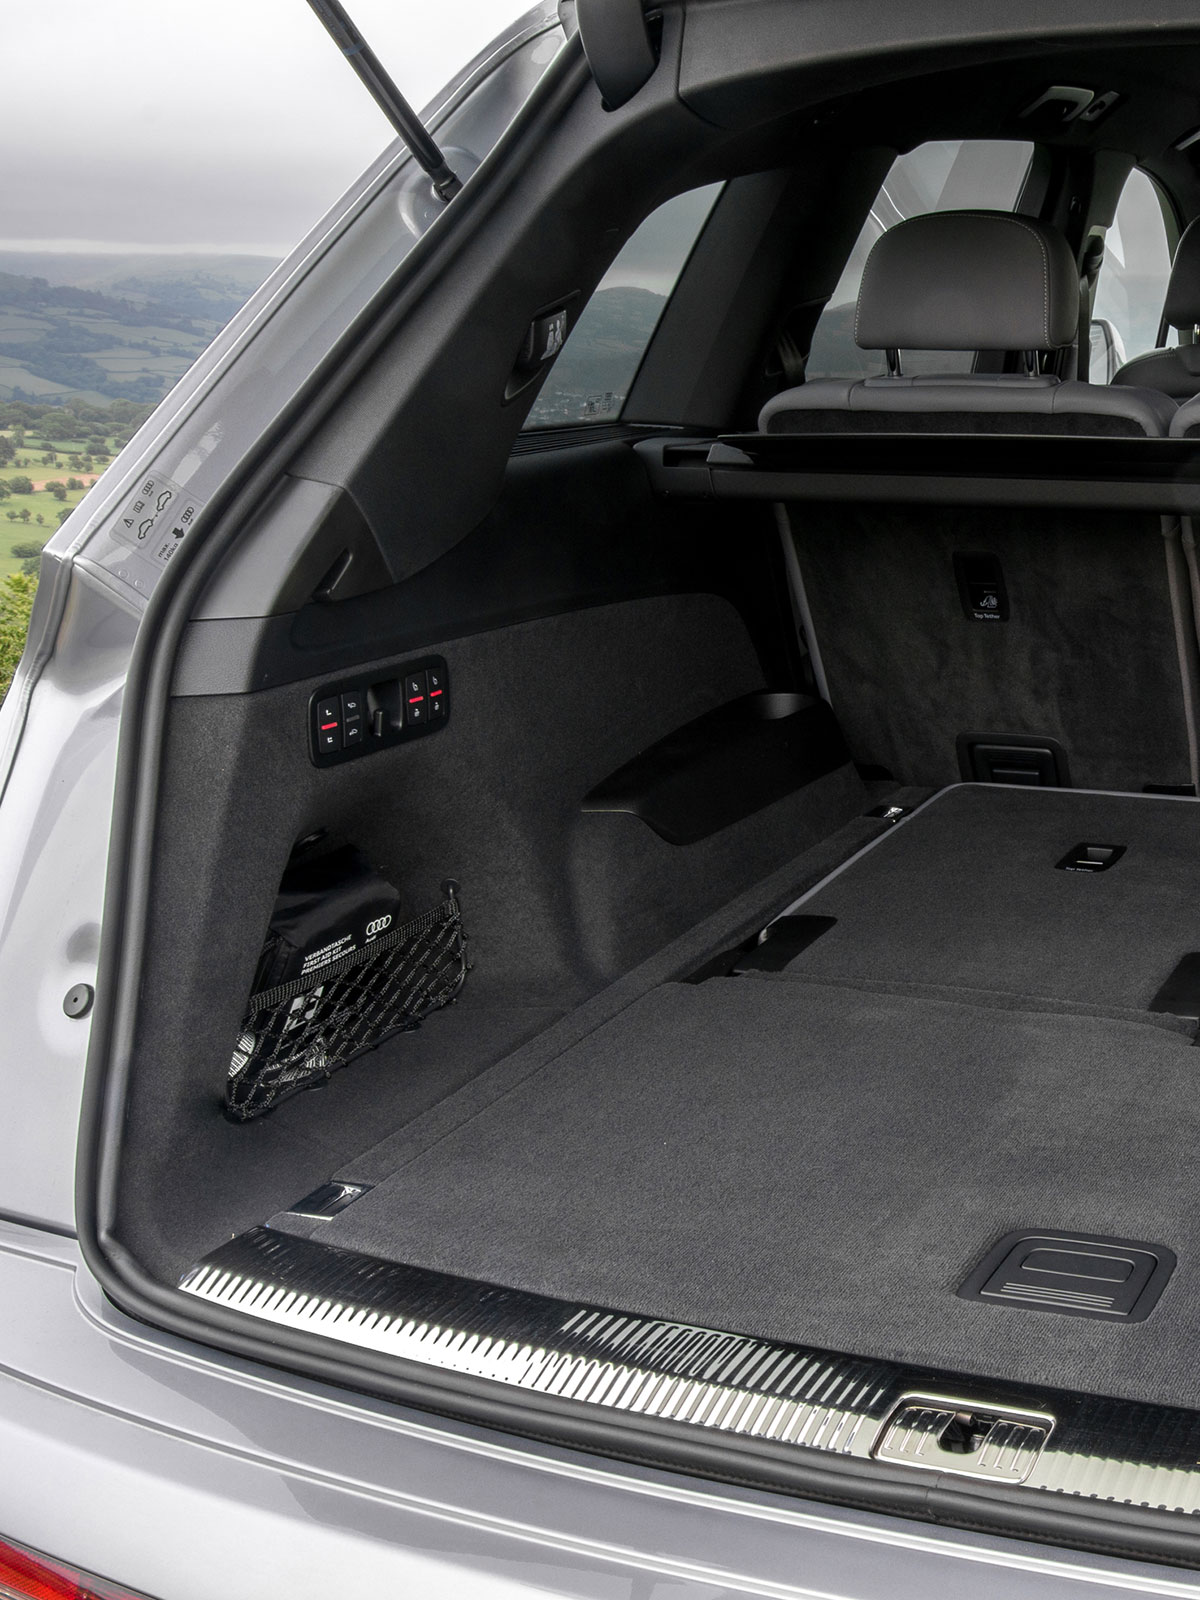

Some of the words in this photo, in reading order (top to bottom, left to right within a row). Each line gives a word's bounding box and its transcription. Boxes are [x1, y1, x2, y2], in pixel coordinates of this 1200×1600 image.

[158, 543, 171, 558] max.
[300, 958, 332, 976] PREMIERS
[332, 944, 357, 961] SECOURS
[302, 957, 321, 969] FIRST
[320, 951, 332, 961] AID
[332, 946, 343, 955] KIT
[304, 933, 353, 962] VERBANDTASCHE
